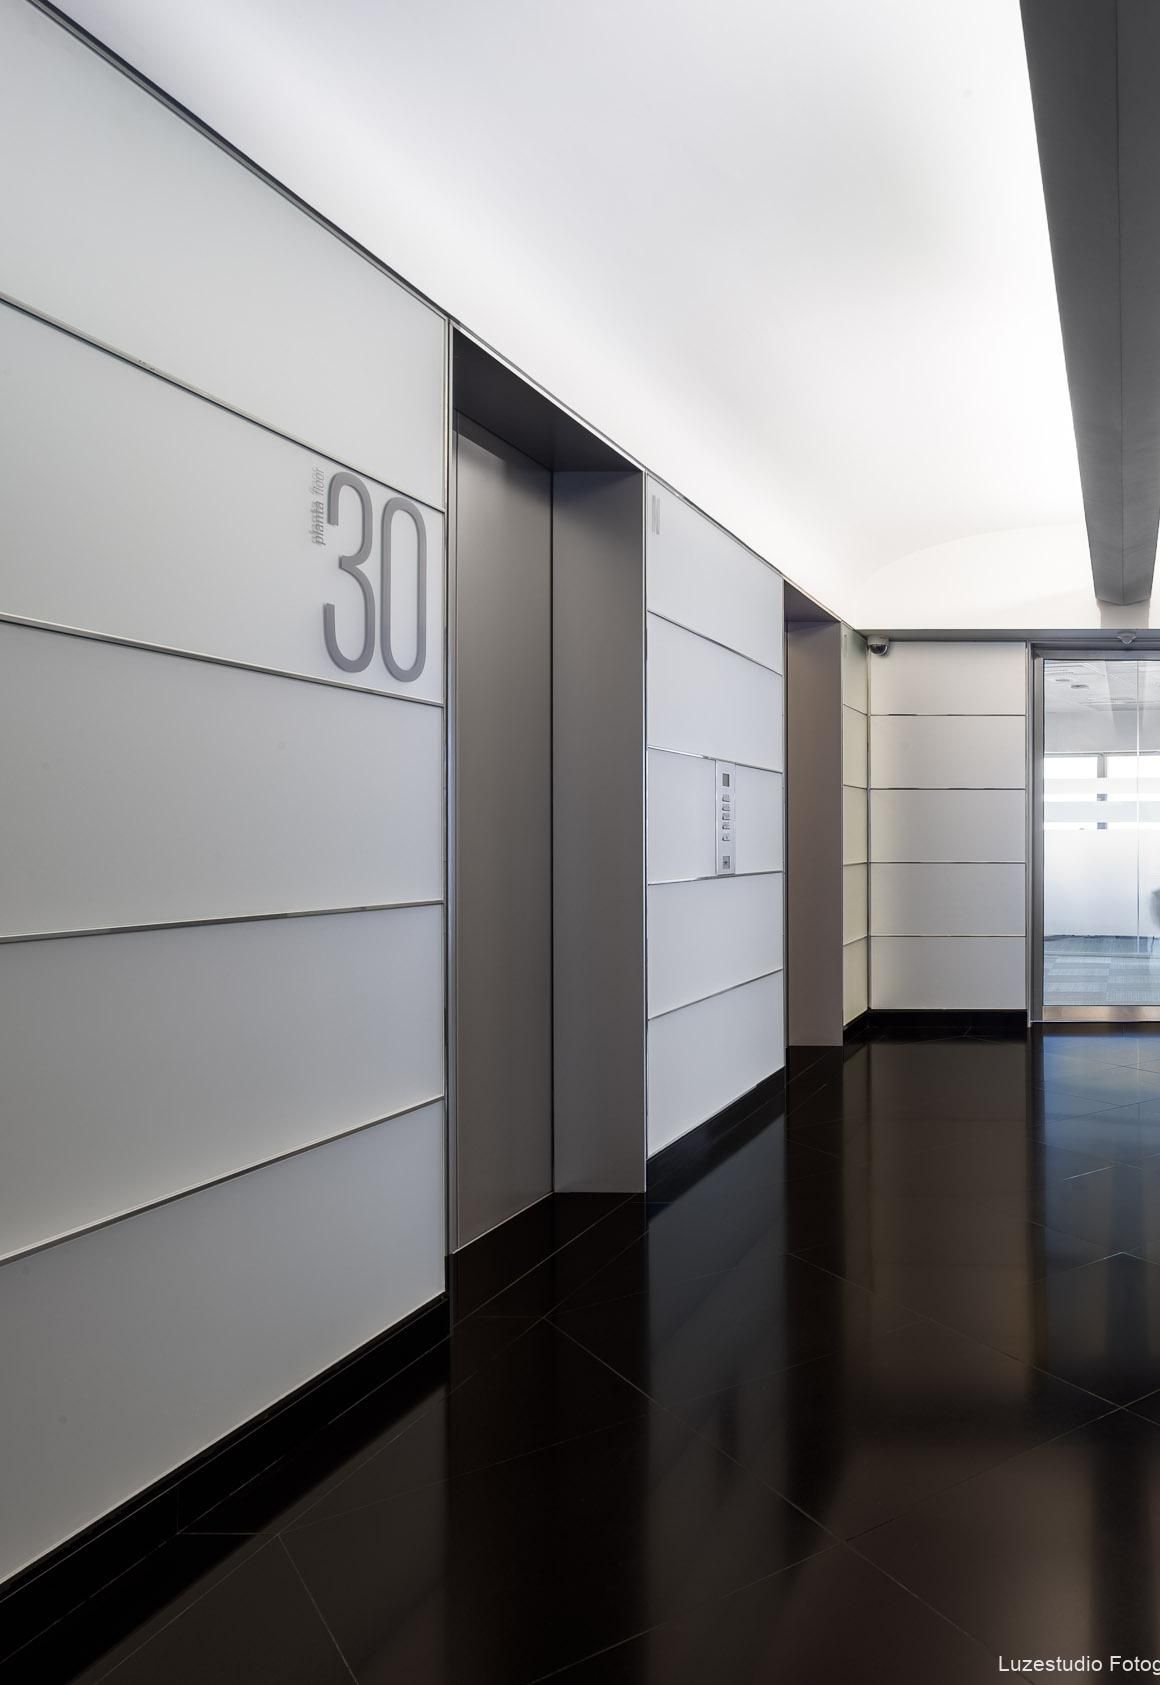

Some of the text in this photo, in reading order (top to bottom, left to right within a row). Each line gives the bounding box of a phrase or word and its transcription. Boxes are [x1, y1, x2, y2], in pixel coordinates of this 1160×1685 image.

[311, 467, 326, 546] planta floor
[323, 471, 427, 683] 30
